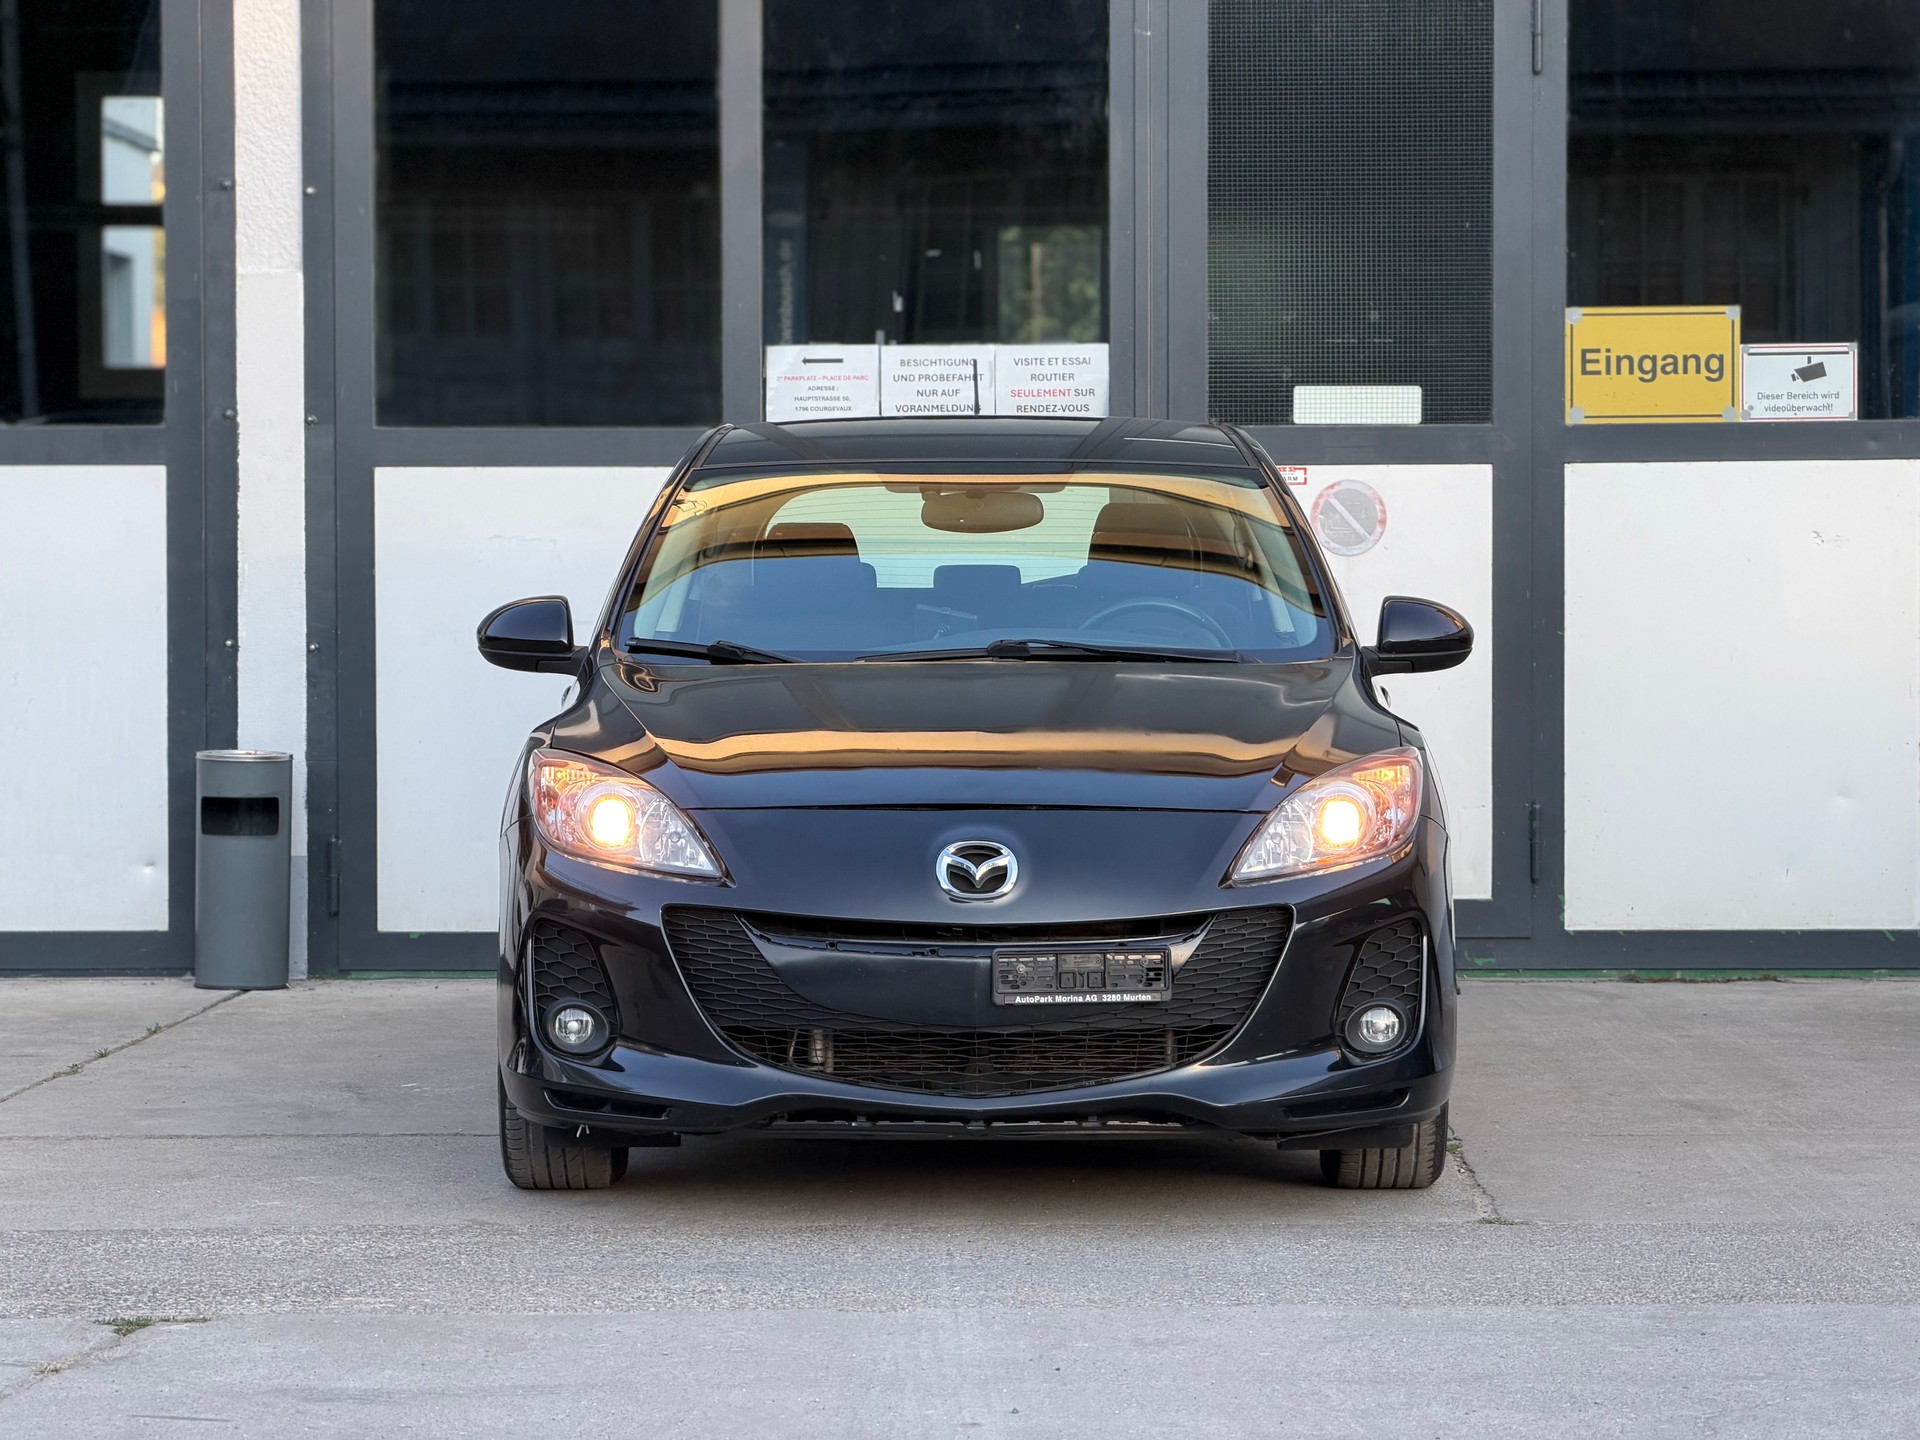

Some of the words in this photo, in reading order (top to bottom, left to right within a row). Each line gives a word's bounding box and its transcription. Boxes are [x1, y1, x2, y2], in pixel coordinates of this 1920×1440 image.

[1013, 357, 1045, 366] VISITE
[1047, 357, 1060, 366] ET
[1062, 357, 1091, 366] ESSAI
[1580, 348, 1725, 383] Eingang
[892, 374, 916, 382] UND
[918, 373, 984, 382] PROBEFAHT
[1030, 373, 1075, 381] ROUTIER
[916, 389, 938, 397] NUR
[940, 389, 961, 397] AUF
[1010, 389, 1072, 398] SEULEMENT
[1073, 388, 1096, 397] SUR
[1757, 392, 1784, 400] Dieser
[1786, 391, 1818, 400] Bereich
[1820, 391, 1840, 399] wird
[1016, 404, 1090, 413] RENDEZ-VOUS
[1764, 403, 1833, 412] videoüberwacht!
[1015, 995, 1053, 1003] AutoPark
[1055, 994, 1083, 1002] Morina
[1085, 994, 1097, 1002] AG
[1123, 993, 1151, 1001] Murten
